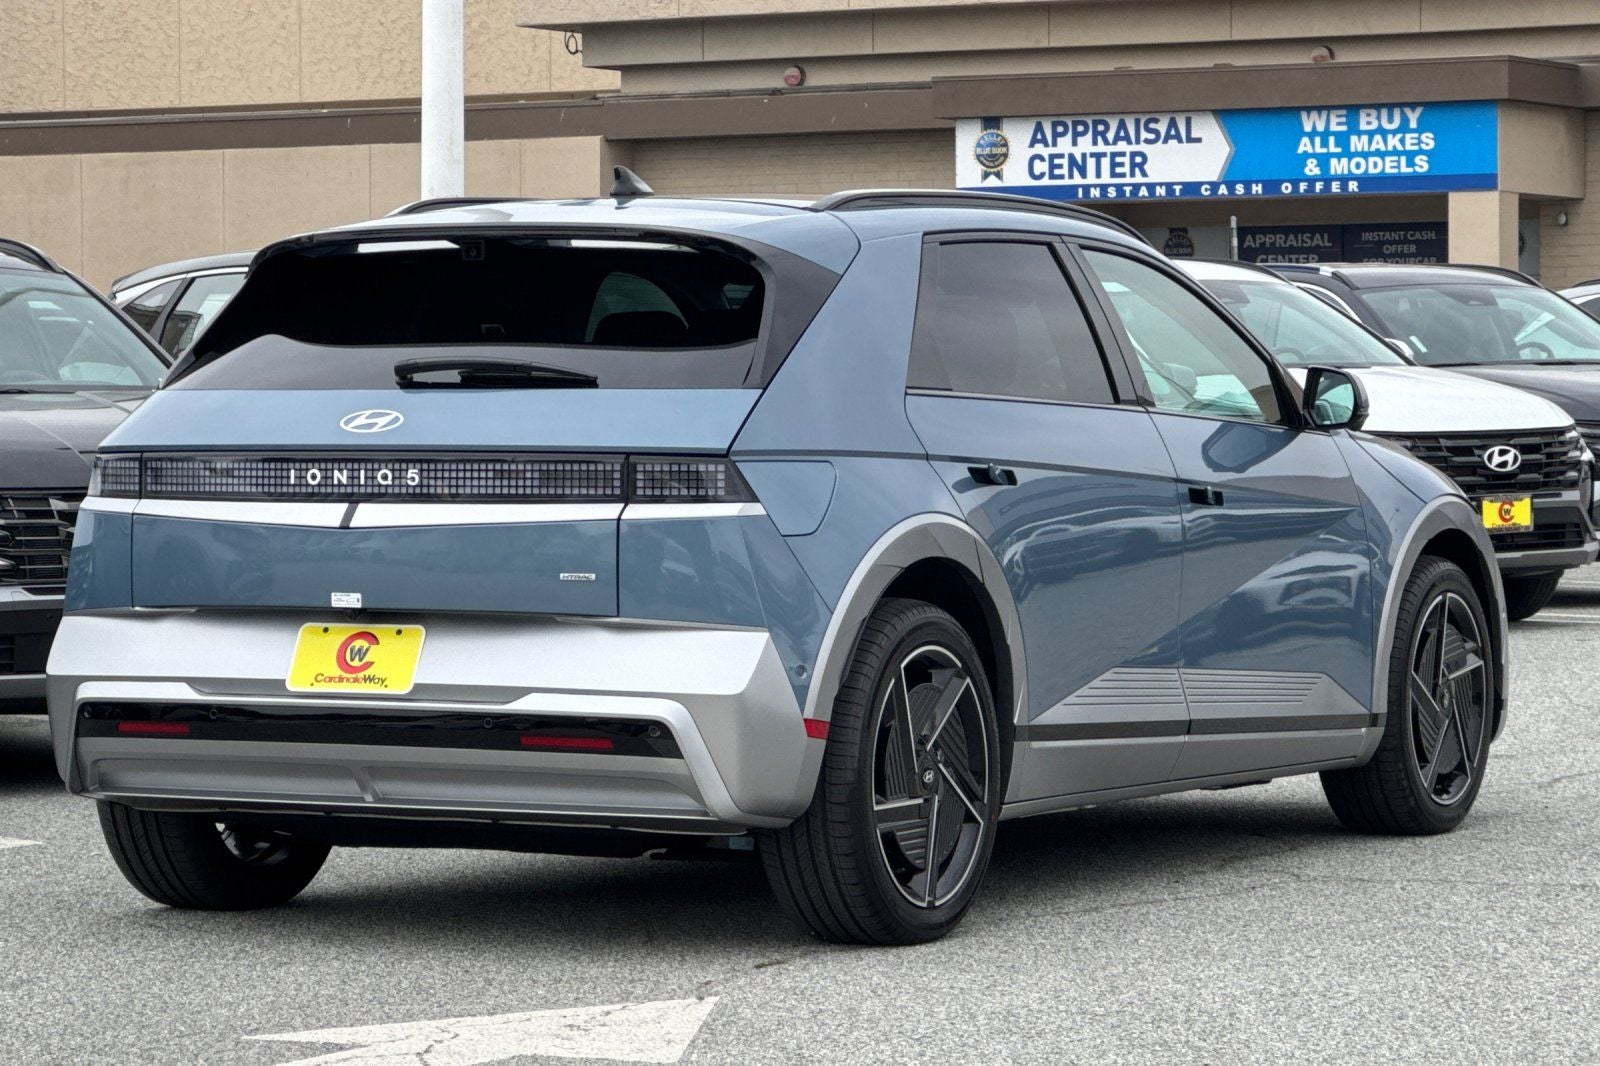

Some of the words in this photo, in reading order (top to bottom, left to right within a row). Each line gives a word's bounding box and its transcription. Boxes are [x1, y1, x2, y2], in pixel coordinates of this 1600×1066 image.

[1299, 109, 1348, 133] WE
[1358, 106, 1424, 131] BUY
[1027, 115, 1203, 149] APPRAISAL
[1296, 136, 1343, 154] ALL
[1349, 132, 1436, 153] MAKES
[1027, 150, 1149, 181] CENTER
[1303, 157, 1322, 176] &
[1329, 154, 1430, 175] MODELS
[1077, 184, 1184, 199] INSTANT
[1200, 183, 1263, 196] CASH
[1281, 180, 1359, 194] OFFER
[1243, 232, 1333, 248] APPRAISAL
[1361, 231, 1405, 241] INSTANT
[1406, 230, 1436, 240] CASH
[1382, 243, 1417, 254] OFFER
[289, 468, 393, 485] IONIQ
[406, 468, 420, 486] 5
[314, 672, 387, 687] CardinaleWay
